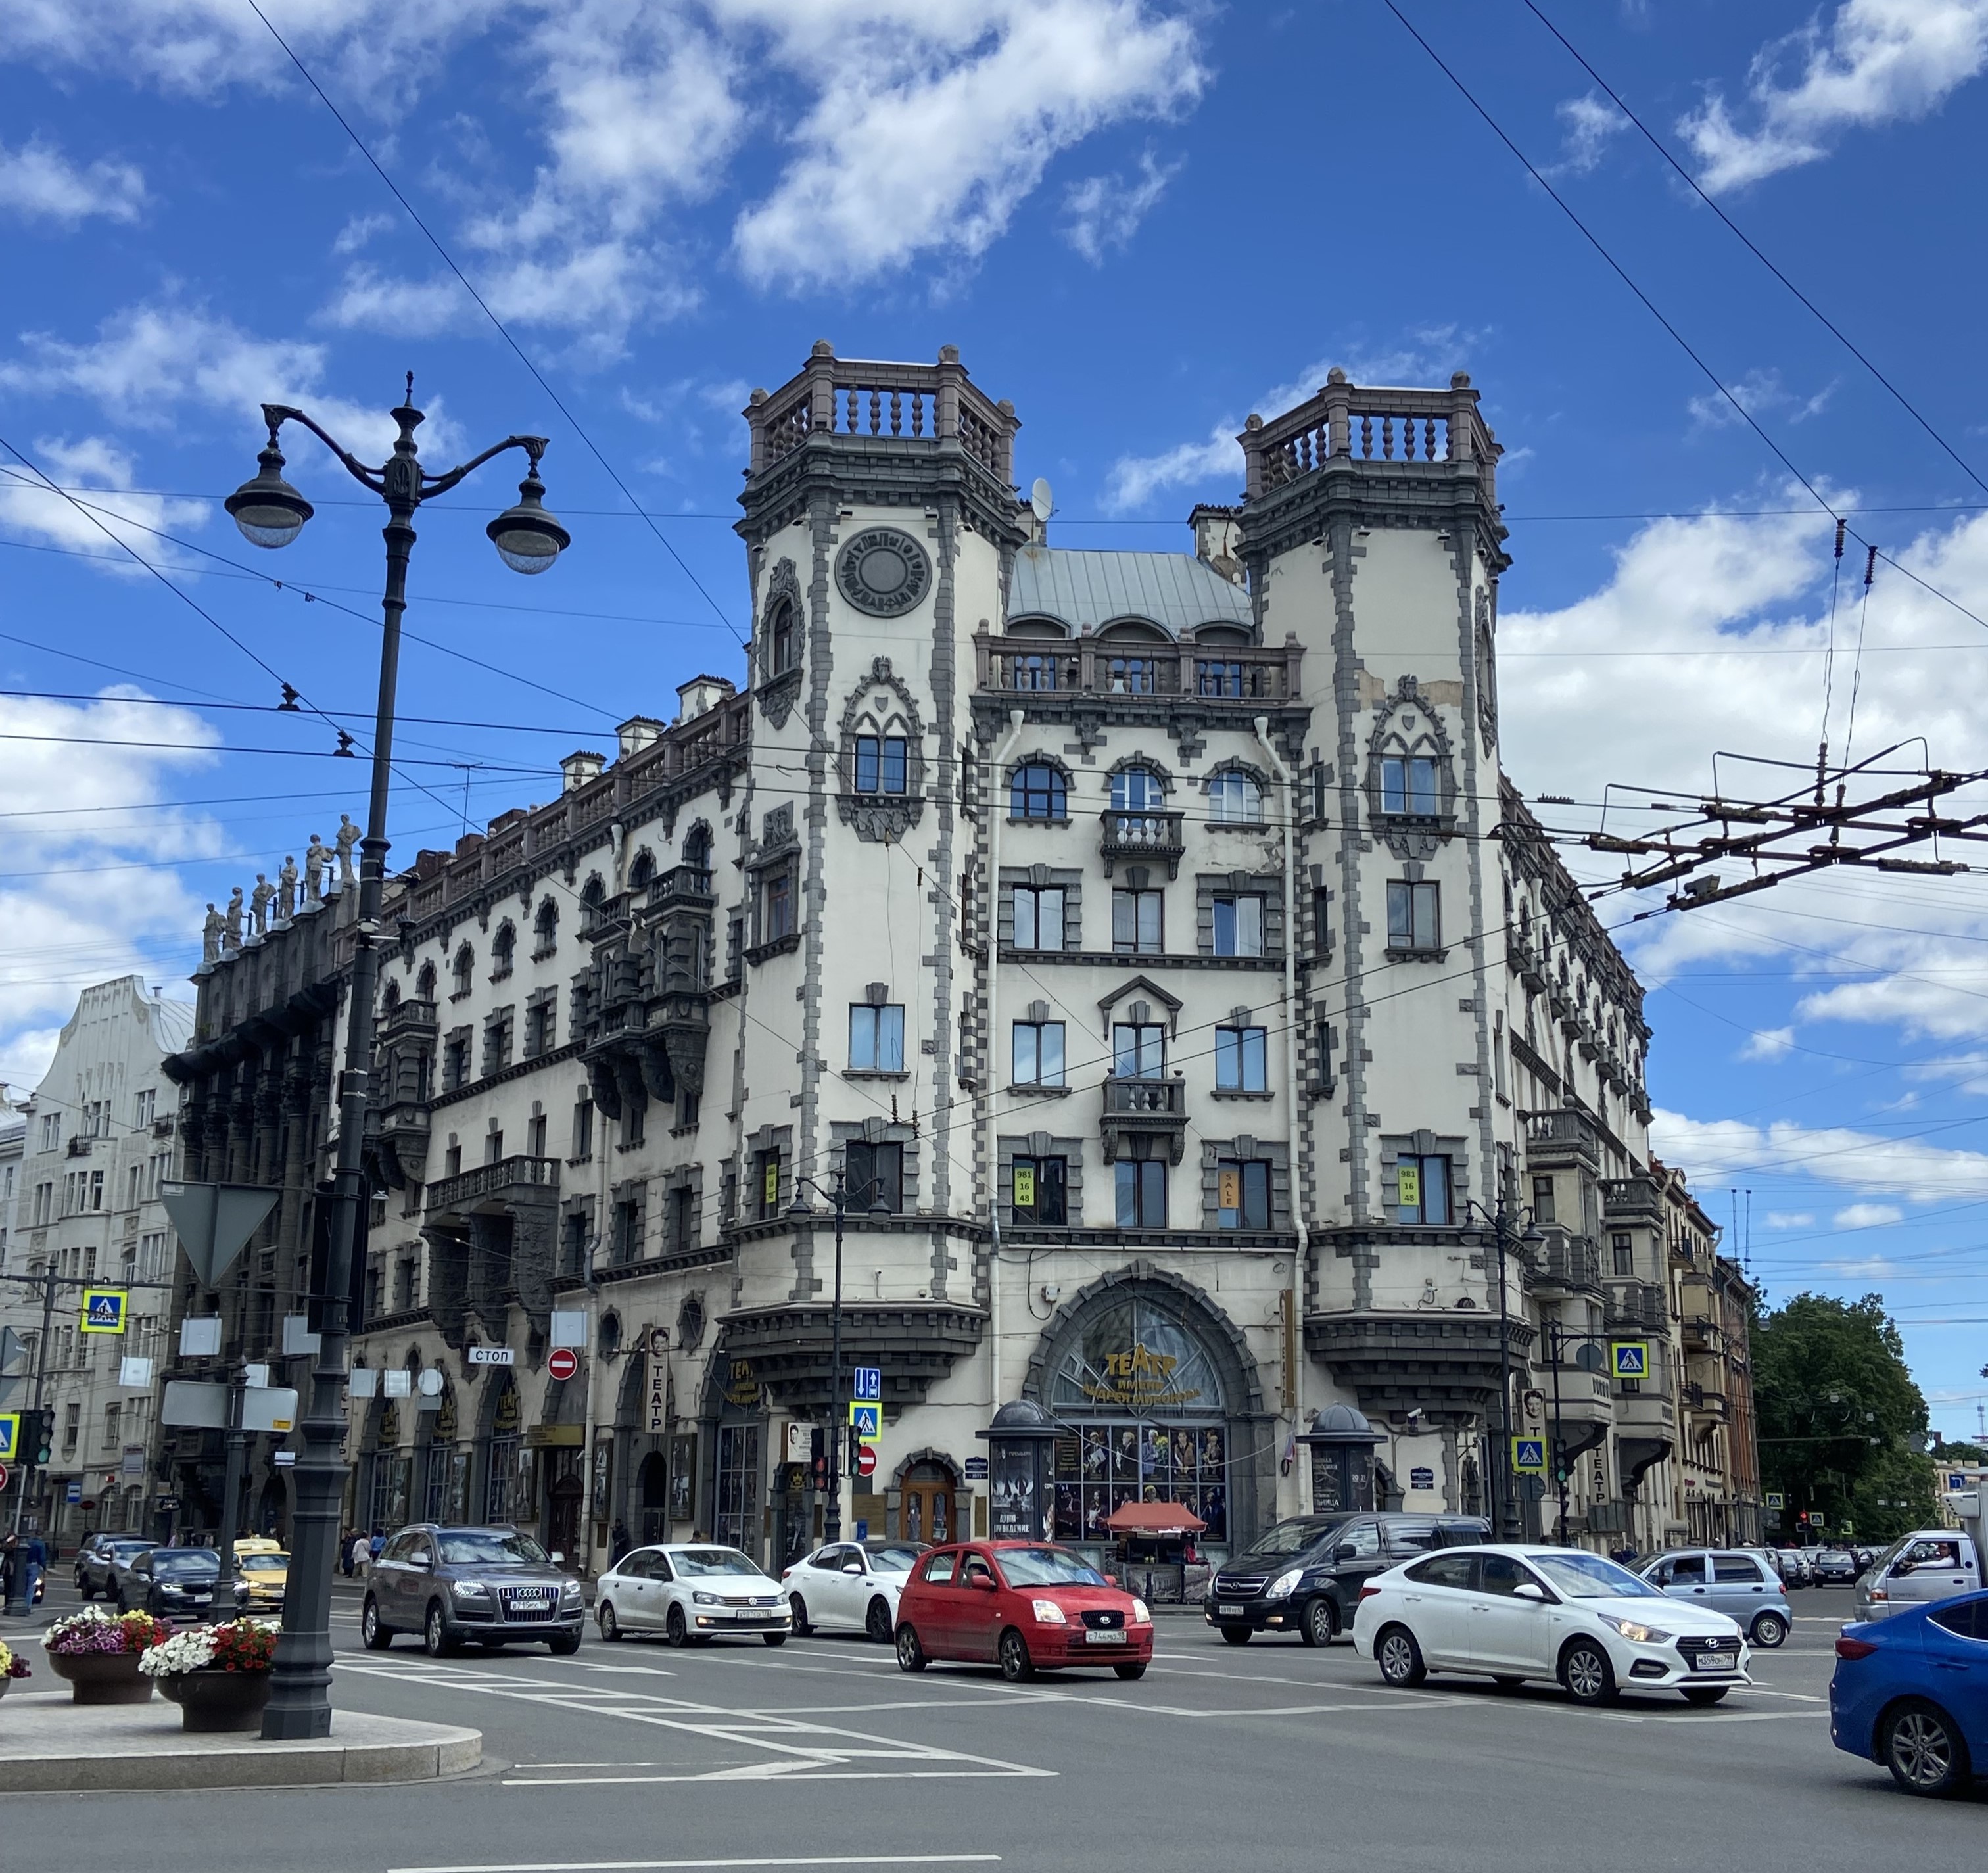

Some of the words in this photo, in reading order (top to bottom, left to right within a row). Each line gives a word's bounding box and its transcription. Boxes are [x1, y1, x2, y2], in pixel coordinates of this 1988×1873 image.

[475, 1350, 508, 1362] СТОП
[1105, 1342, 1177, 1376] ТЕАТР
[730, 1360, 753, 1380] ТЕА
[651, 1365, 663, 1430] ТЕАТР
[1118, 1380, 1164, 1391] ИМЕНИ
[1593, 1448, 1605, 1503] ТЕАТР
